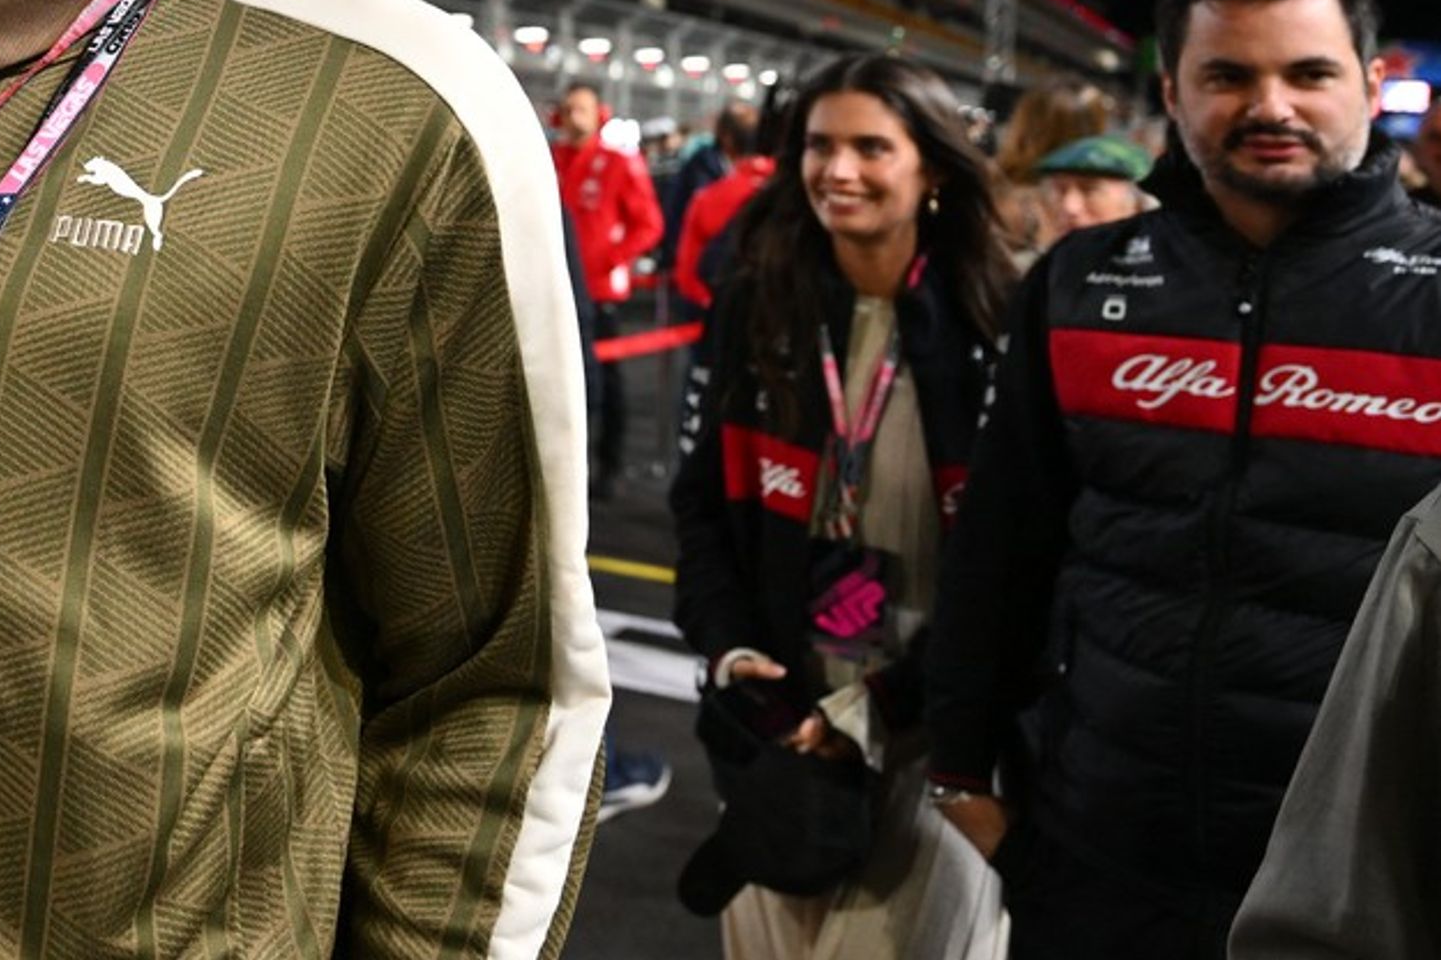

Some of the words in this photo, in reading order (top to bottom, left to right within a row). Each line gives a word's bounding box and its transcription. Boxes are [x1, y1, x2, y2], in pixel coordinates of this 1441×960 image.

[10, 142, 49, 184] LAS
[37, 78, 98, 140] VEGAS
[50, 214, 146, 256] PUMA
[1111, 353, 1236, 409] Alfa
[1253, 363, 1441, 424] Romeo
